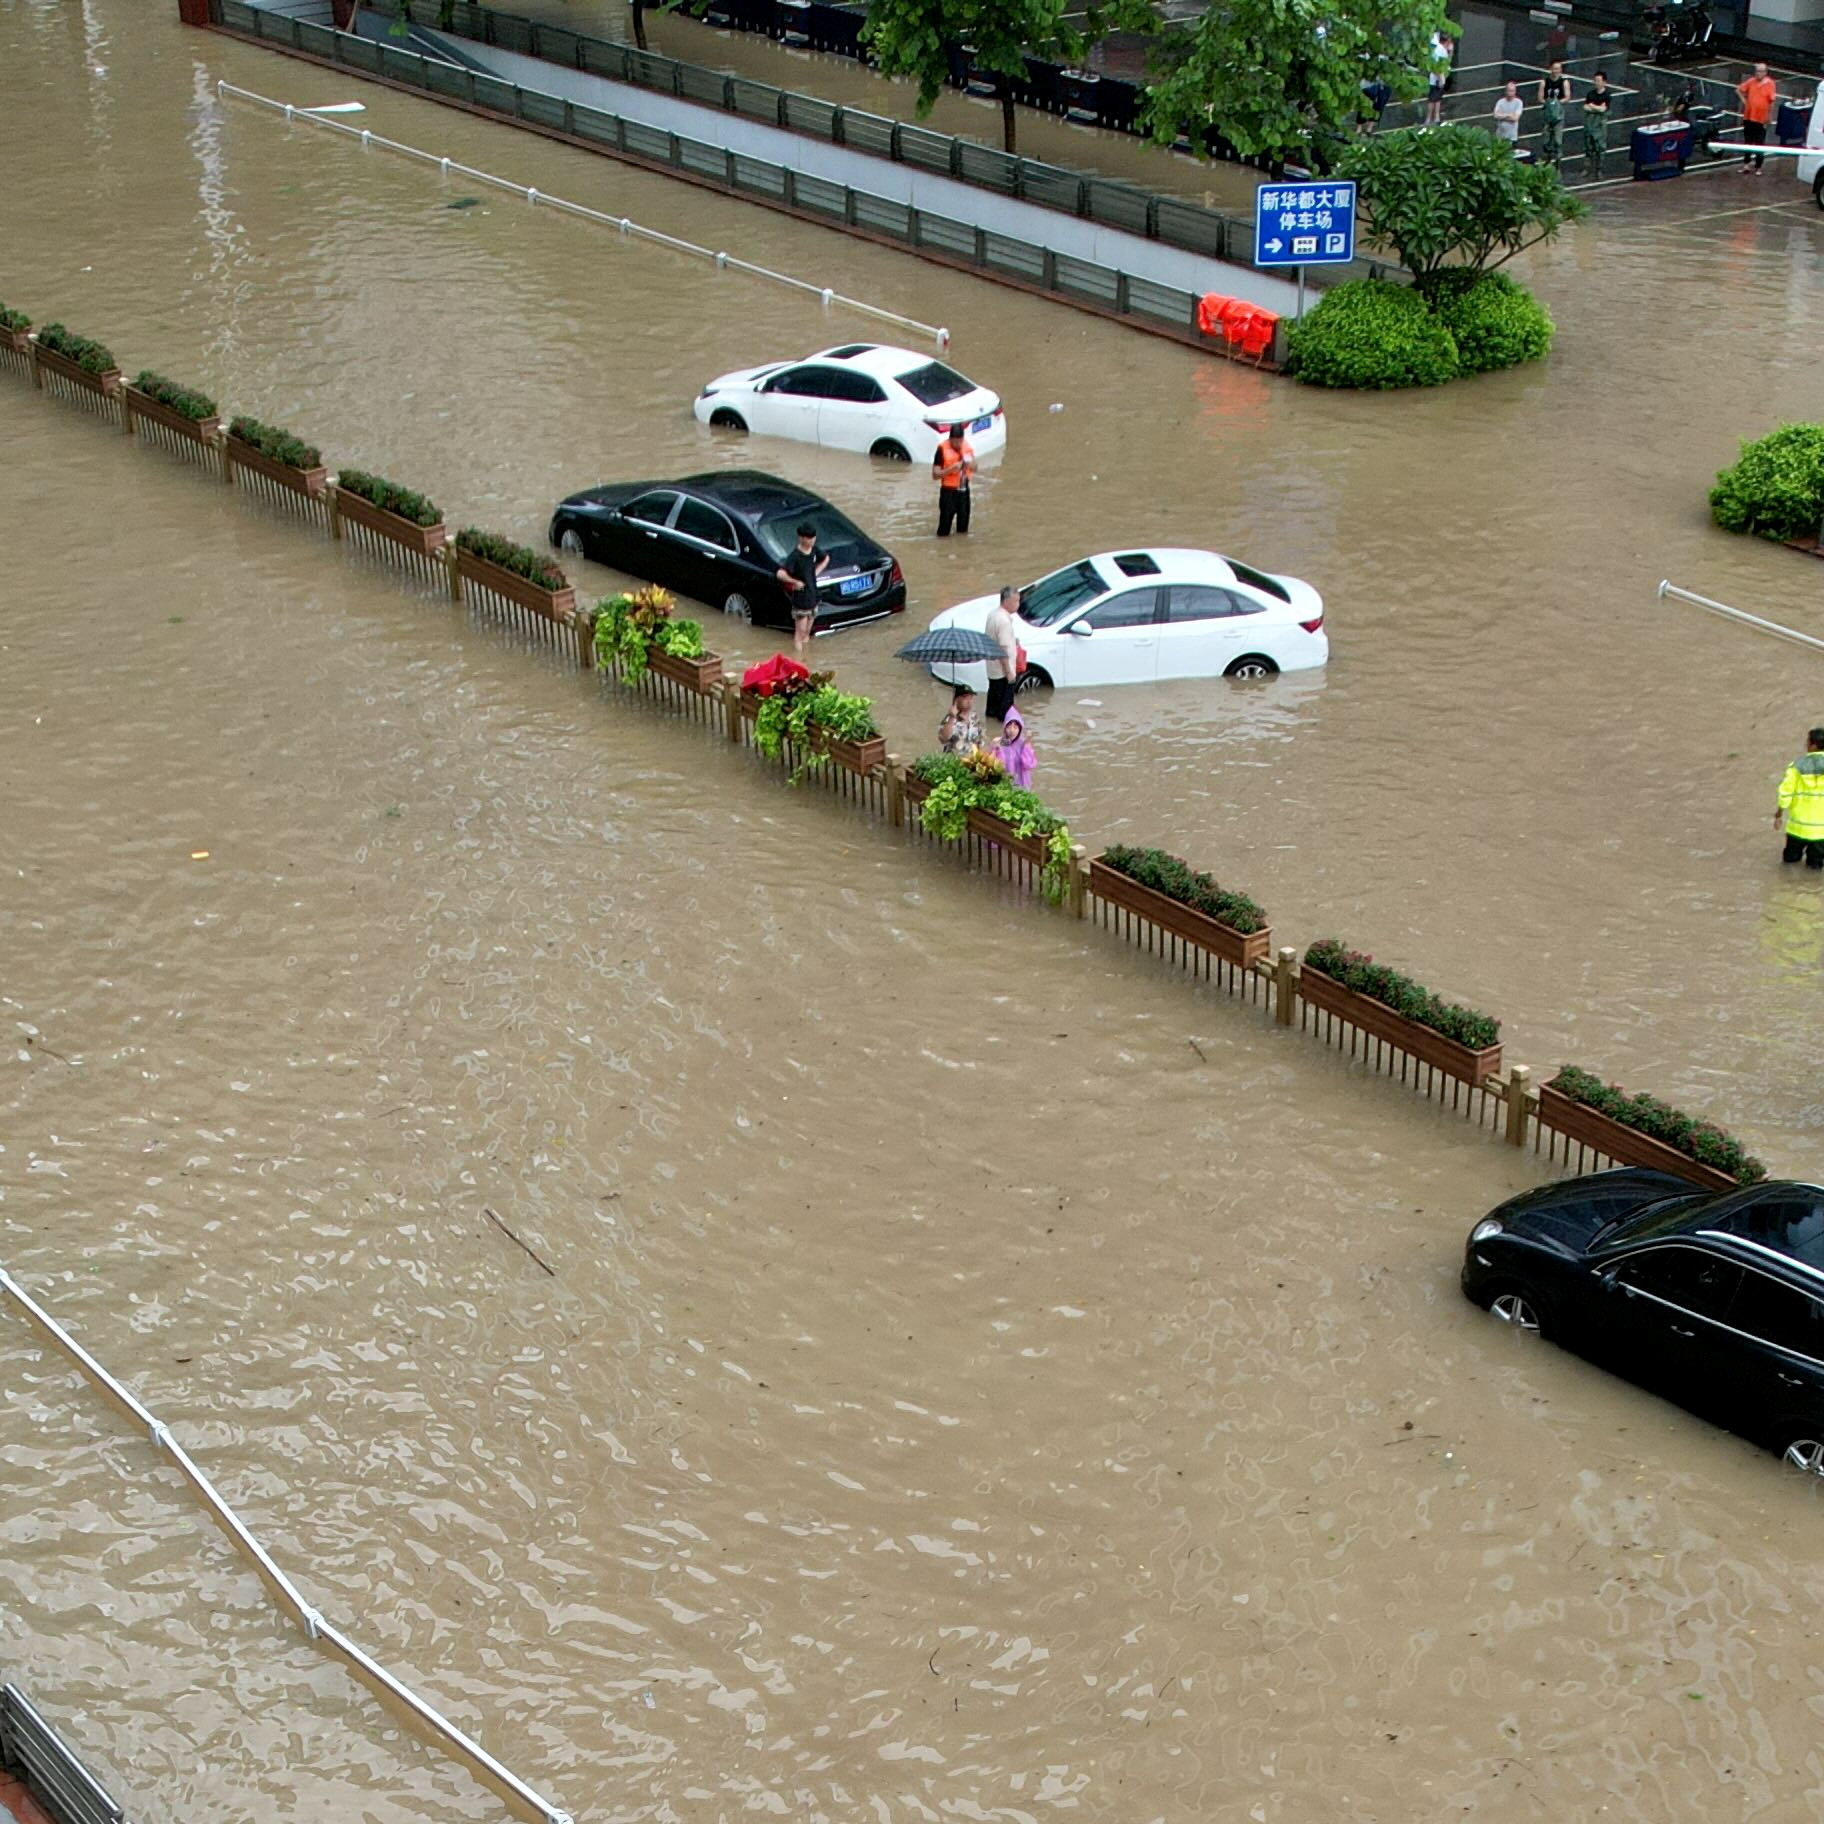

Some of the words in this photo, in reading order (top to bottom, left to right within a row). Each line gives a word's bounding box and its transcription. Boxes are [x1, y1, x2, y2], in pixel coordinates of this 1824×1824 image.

[1262, 189, 1351, 211] 新华都大厦
[1279, 210, 1333, 231] 停车场
[1329, 235, 1342, 252] P
